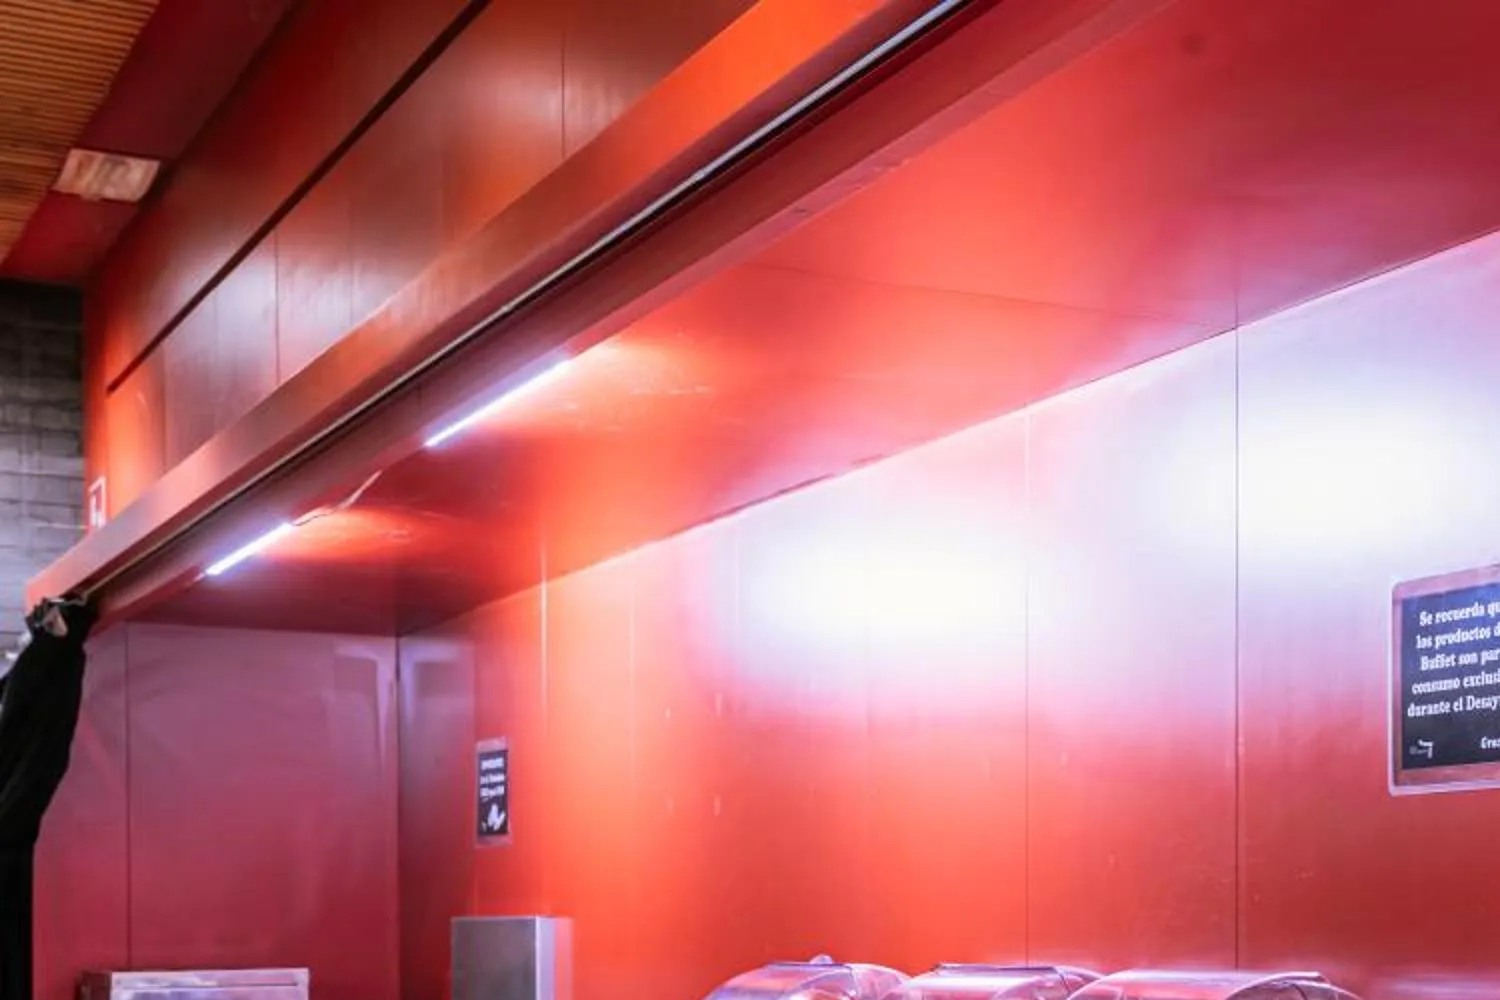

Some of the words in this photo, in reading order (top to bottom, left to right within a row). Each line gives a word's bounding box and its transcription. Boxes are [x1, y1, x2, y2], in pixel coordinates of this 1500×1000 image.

[1419, 611, 1432, 626] Se
[1435, 602, 1485, 623] recuerda
[1434, 626, 1491, 649] productos
[1420, 653, 1457, 671] Buffet
[1458, 652, 1478, 666] son
[1412, 677, 1461, 695] consumo
[1407, 700, 1451, 717] durante
[1453, 697, 1463, 712] el
